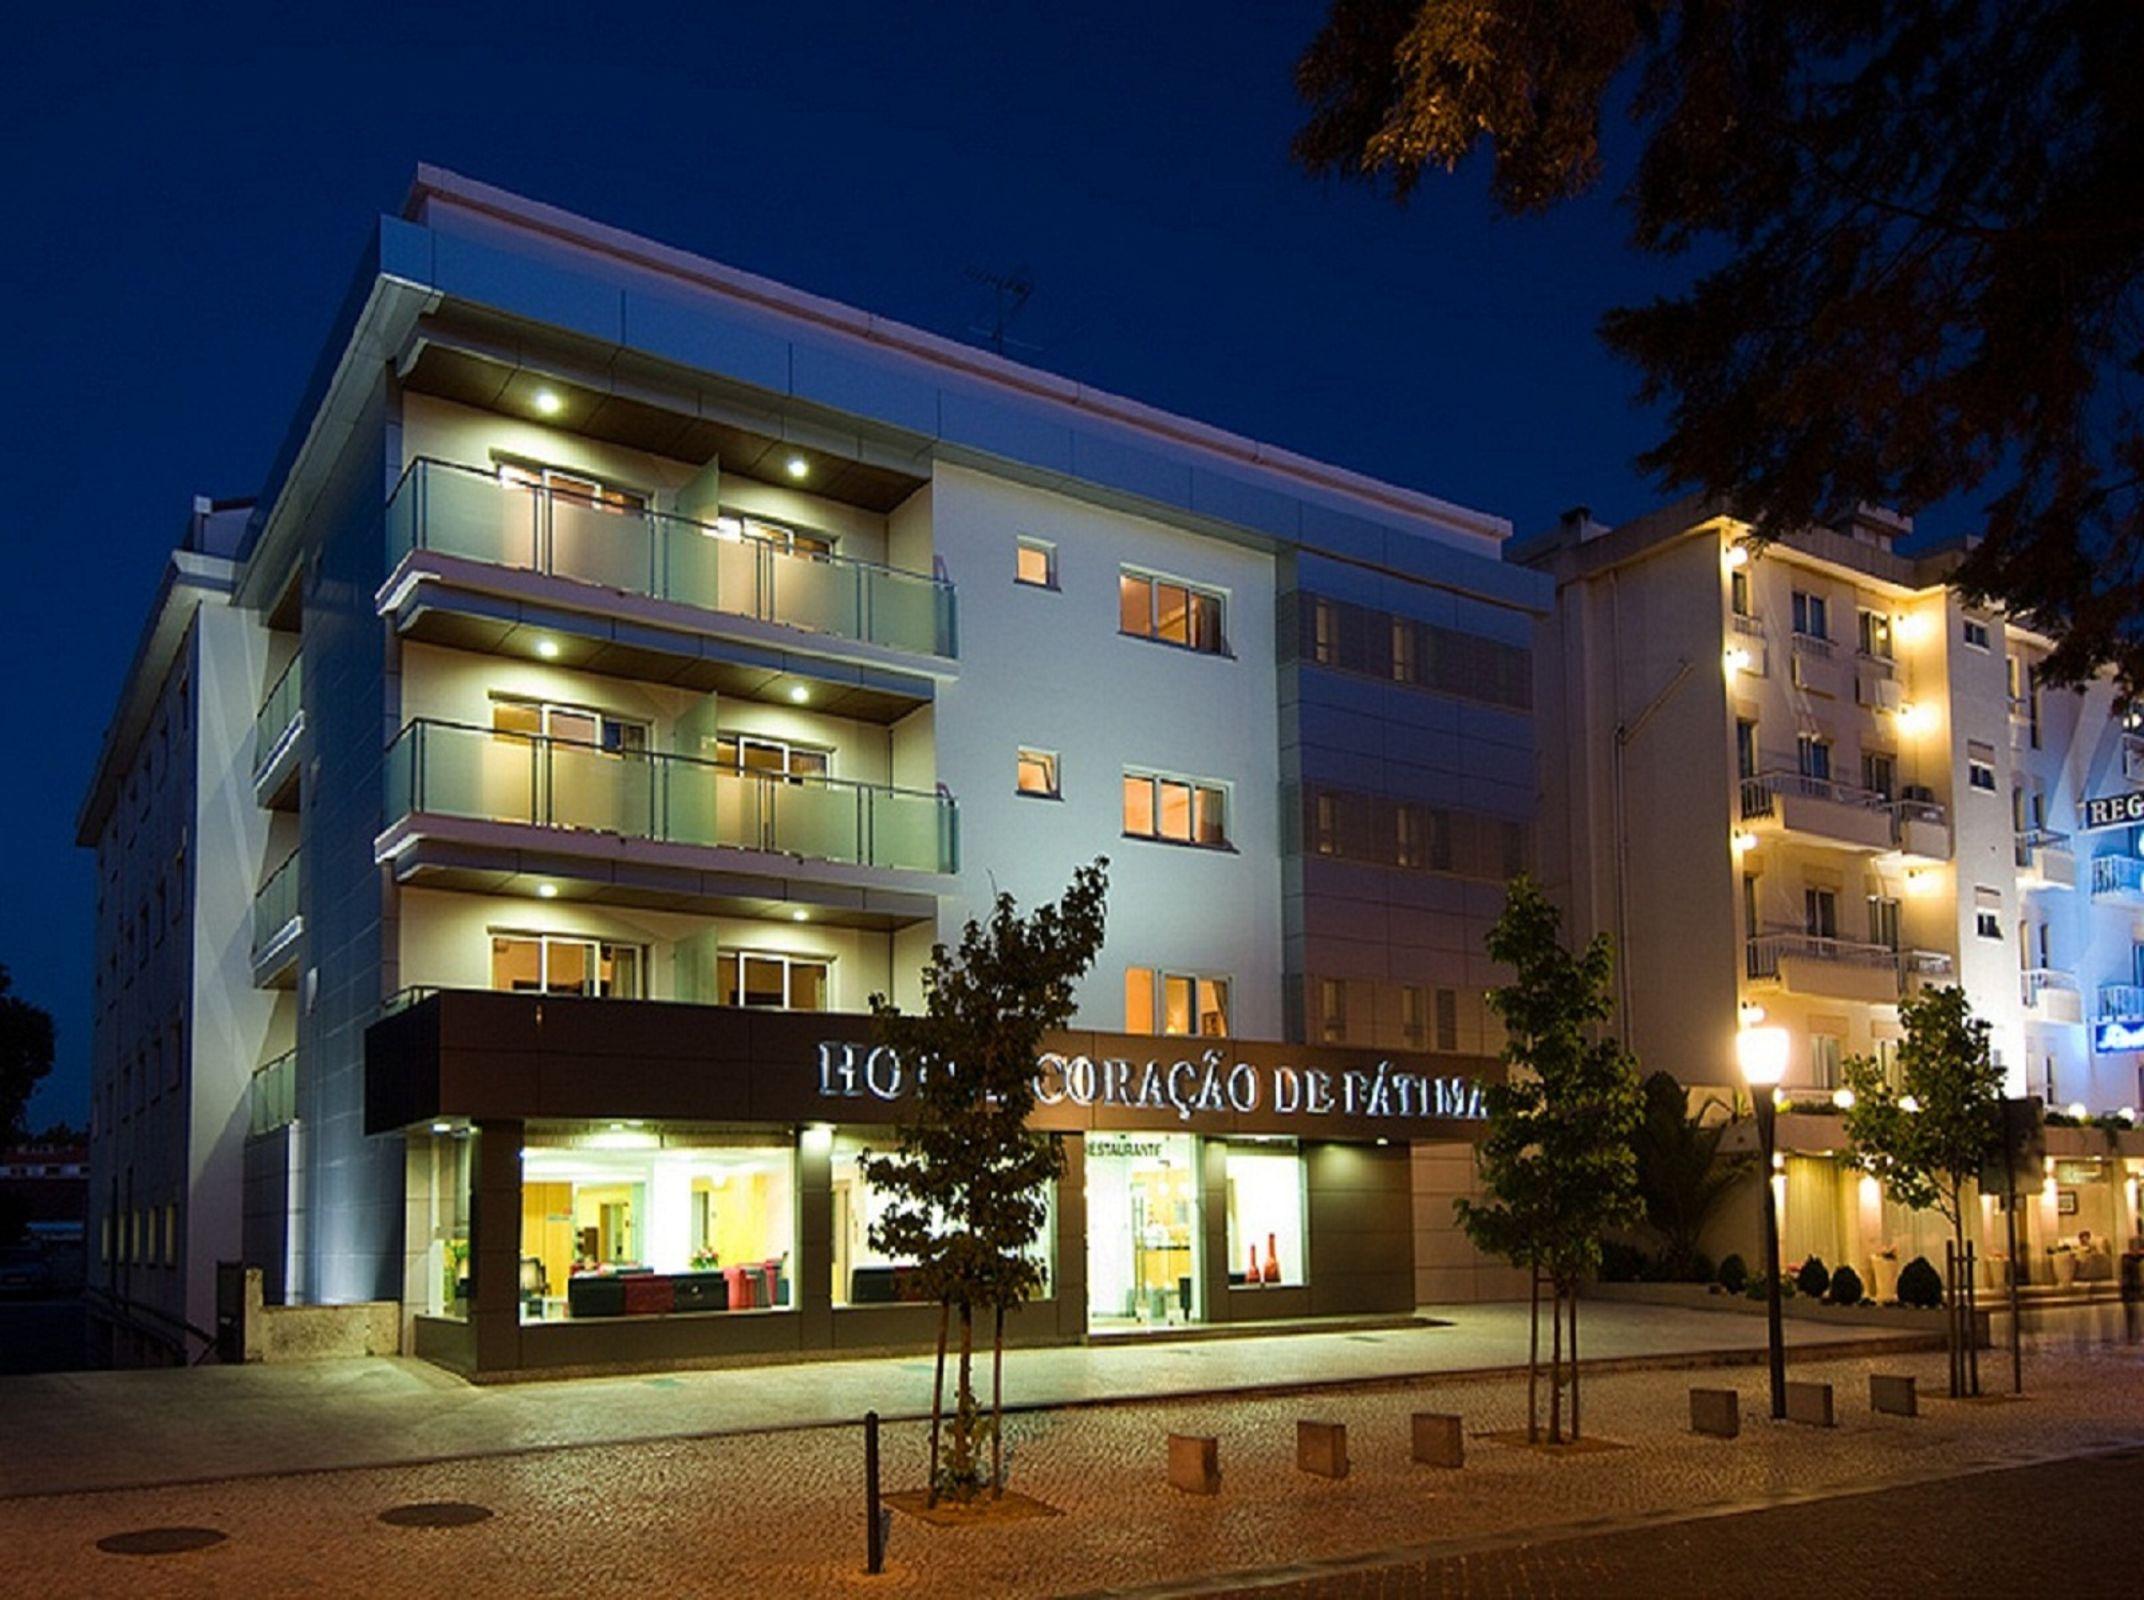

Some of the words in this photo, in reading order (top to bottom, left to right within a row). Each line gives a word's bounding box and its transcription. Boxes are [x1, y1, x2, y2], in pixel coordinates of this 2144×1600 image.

[1032, 1049, 1261, 1120] CORAÇÃO
[1274, 1065, 1336, 1114] DE
[1342, 1060, 1490, 1120] FÁTIMA
